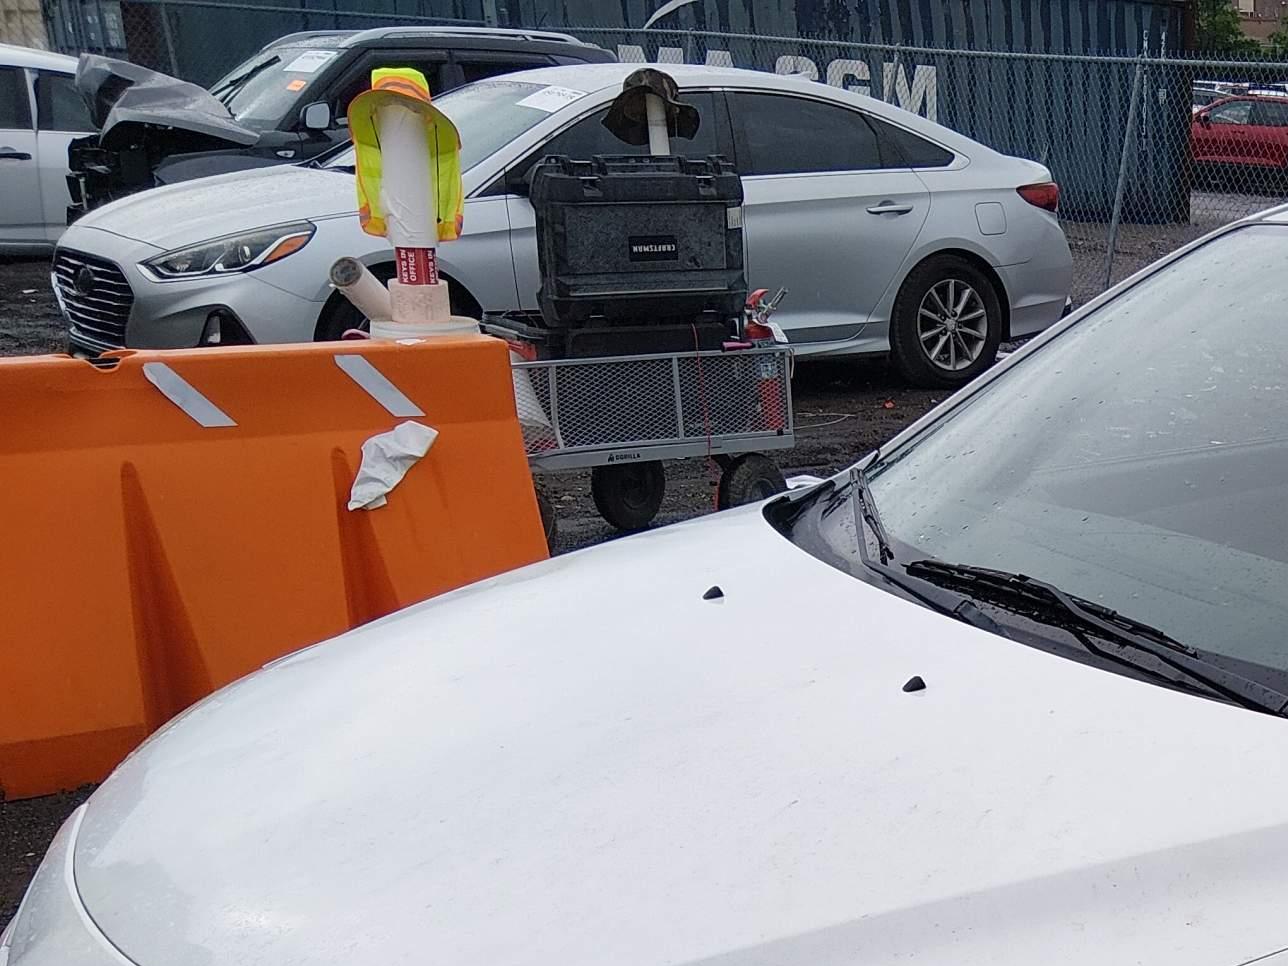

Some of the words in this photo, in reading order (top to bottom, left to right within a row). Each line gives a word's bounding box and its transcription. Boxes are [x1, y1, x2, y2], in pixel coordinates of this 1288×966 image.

[632, 243, 676, 253] CRAFTSMAN
[401, 260, 409, 283] KEYS
[407, 251, 417, 282] OFFICE
